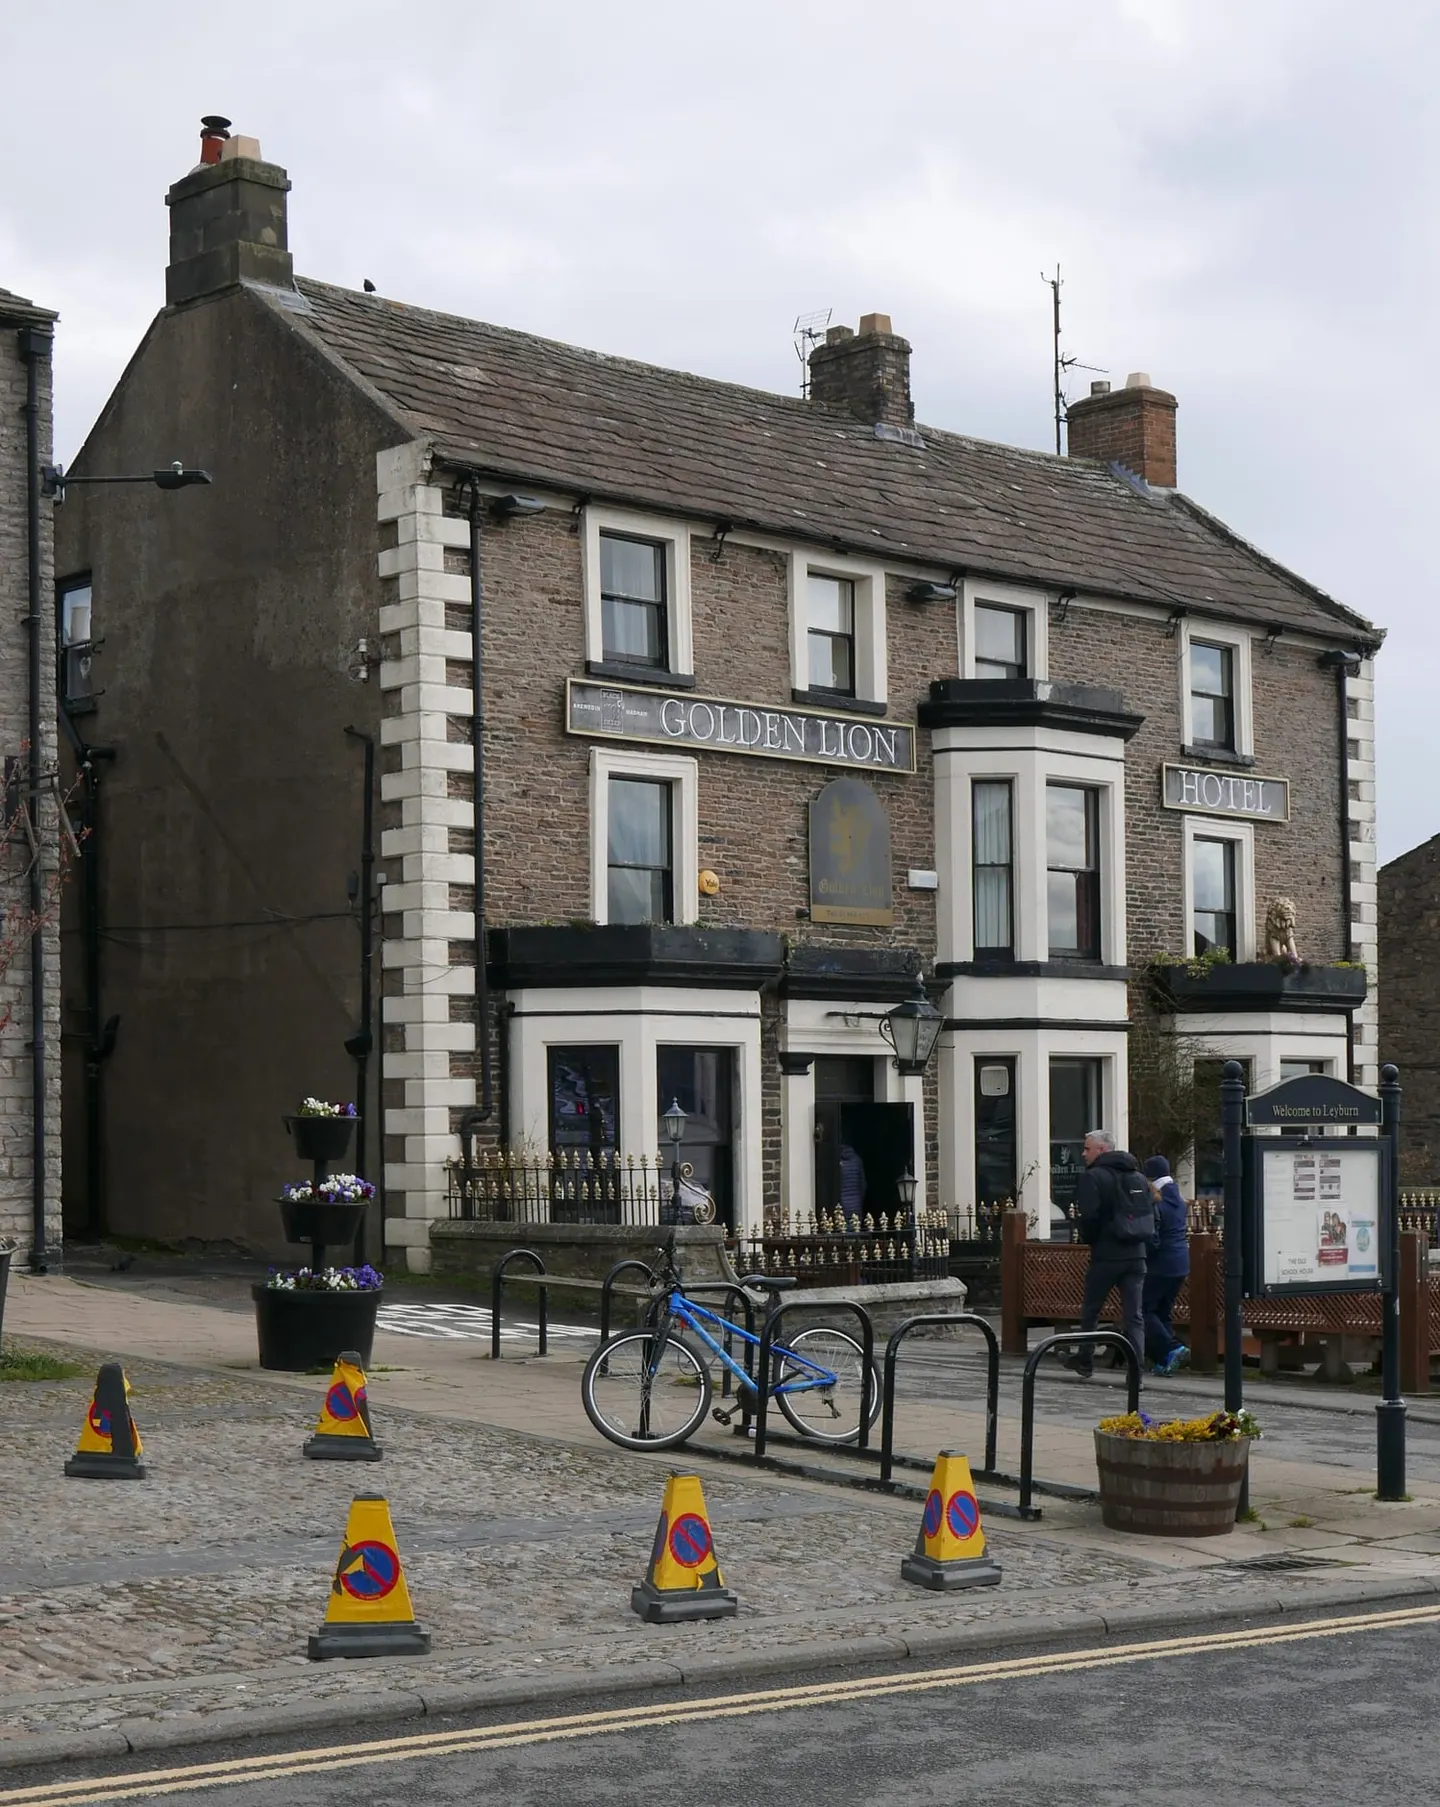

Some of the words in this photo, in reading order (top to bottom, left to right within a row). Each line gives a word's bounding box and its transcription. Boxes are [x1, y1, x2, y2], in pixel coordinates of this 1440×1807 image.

[660, 699, 806, 752] GOLDEN
[817, 720, 897, 764] LION
[1178, 770, 1272, 814] HOTEL
[1272, 1104, 1310, 1117] Welcome
[1312, 1106, 1321, 1117] to
[1322, 1104, 1359, 1119] Leyburn
